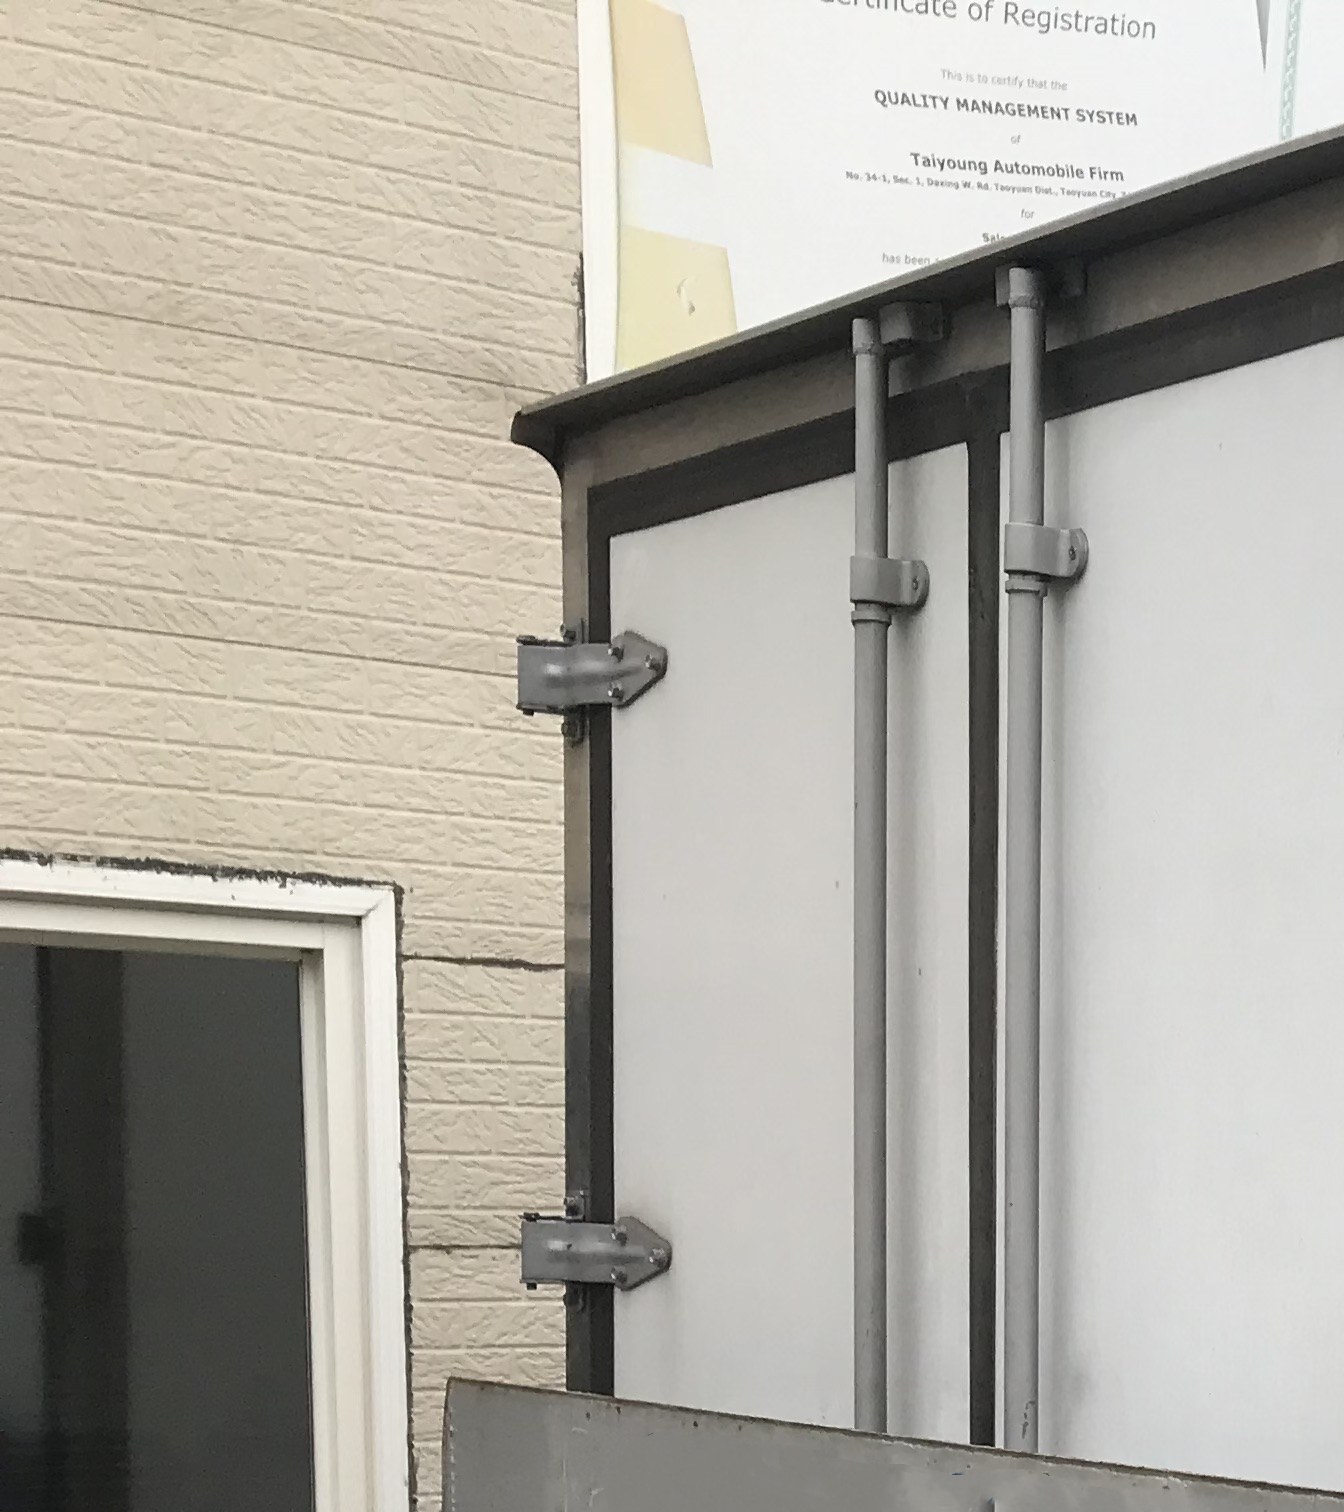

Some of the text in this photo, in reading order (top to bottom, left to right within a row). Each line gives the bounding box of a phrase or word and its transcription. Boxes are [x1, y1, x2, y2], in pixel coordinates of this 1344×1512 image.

[967, 0, 994, 23] of
[1004, 2, 1156, 40] Registration
[940, 68, 1068, 91] This is to certify that the
[874, 89, 1138, 127] QUALITY MANAGEMENT SYSTEM
[1010, 133, 1021, 145] of
[910, 152, 1125, 182] Taiyoung Automobile Firm
[1020, 208, 1035, 220] for
[882, 251, 902, 264] has
[904, 253, 931, 265] been
